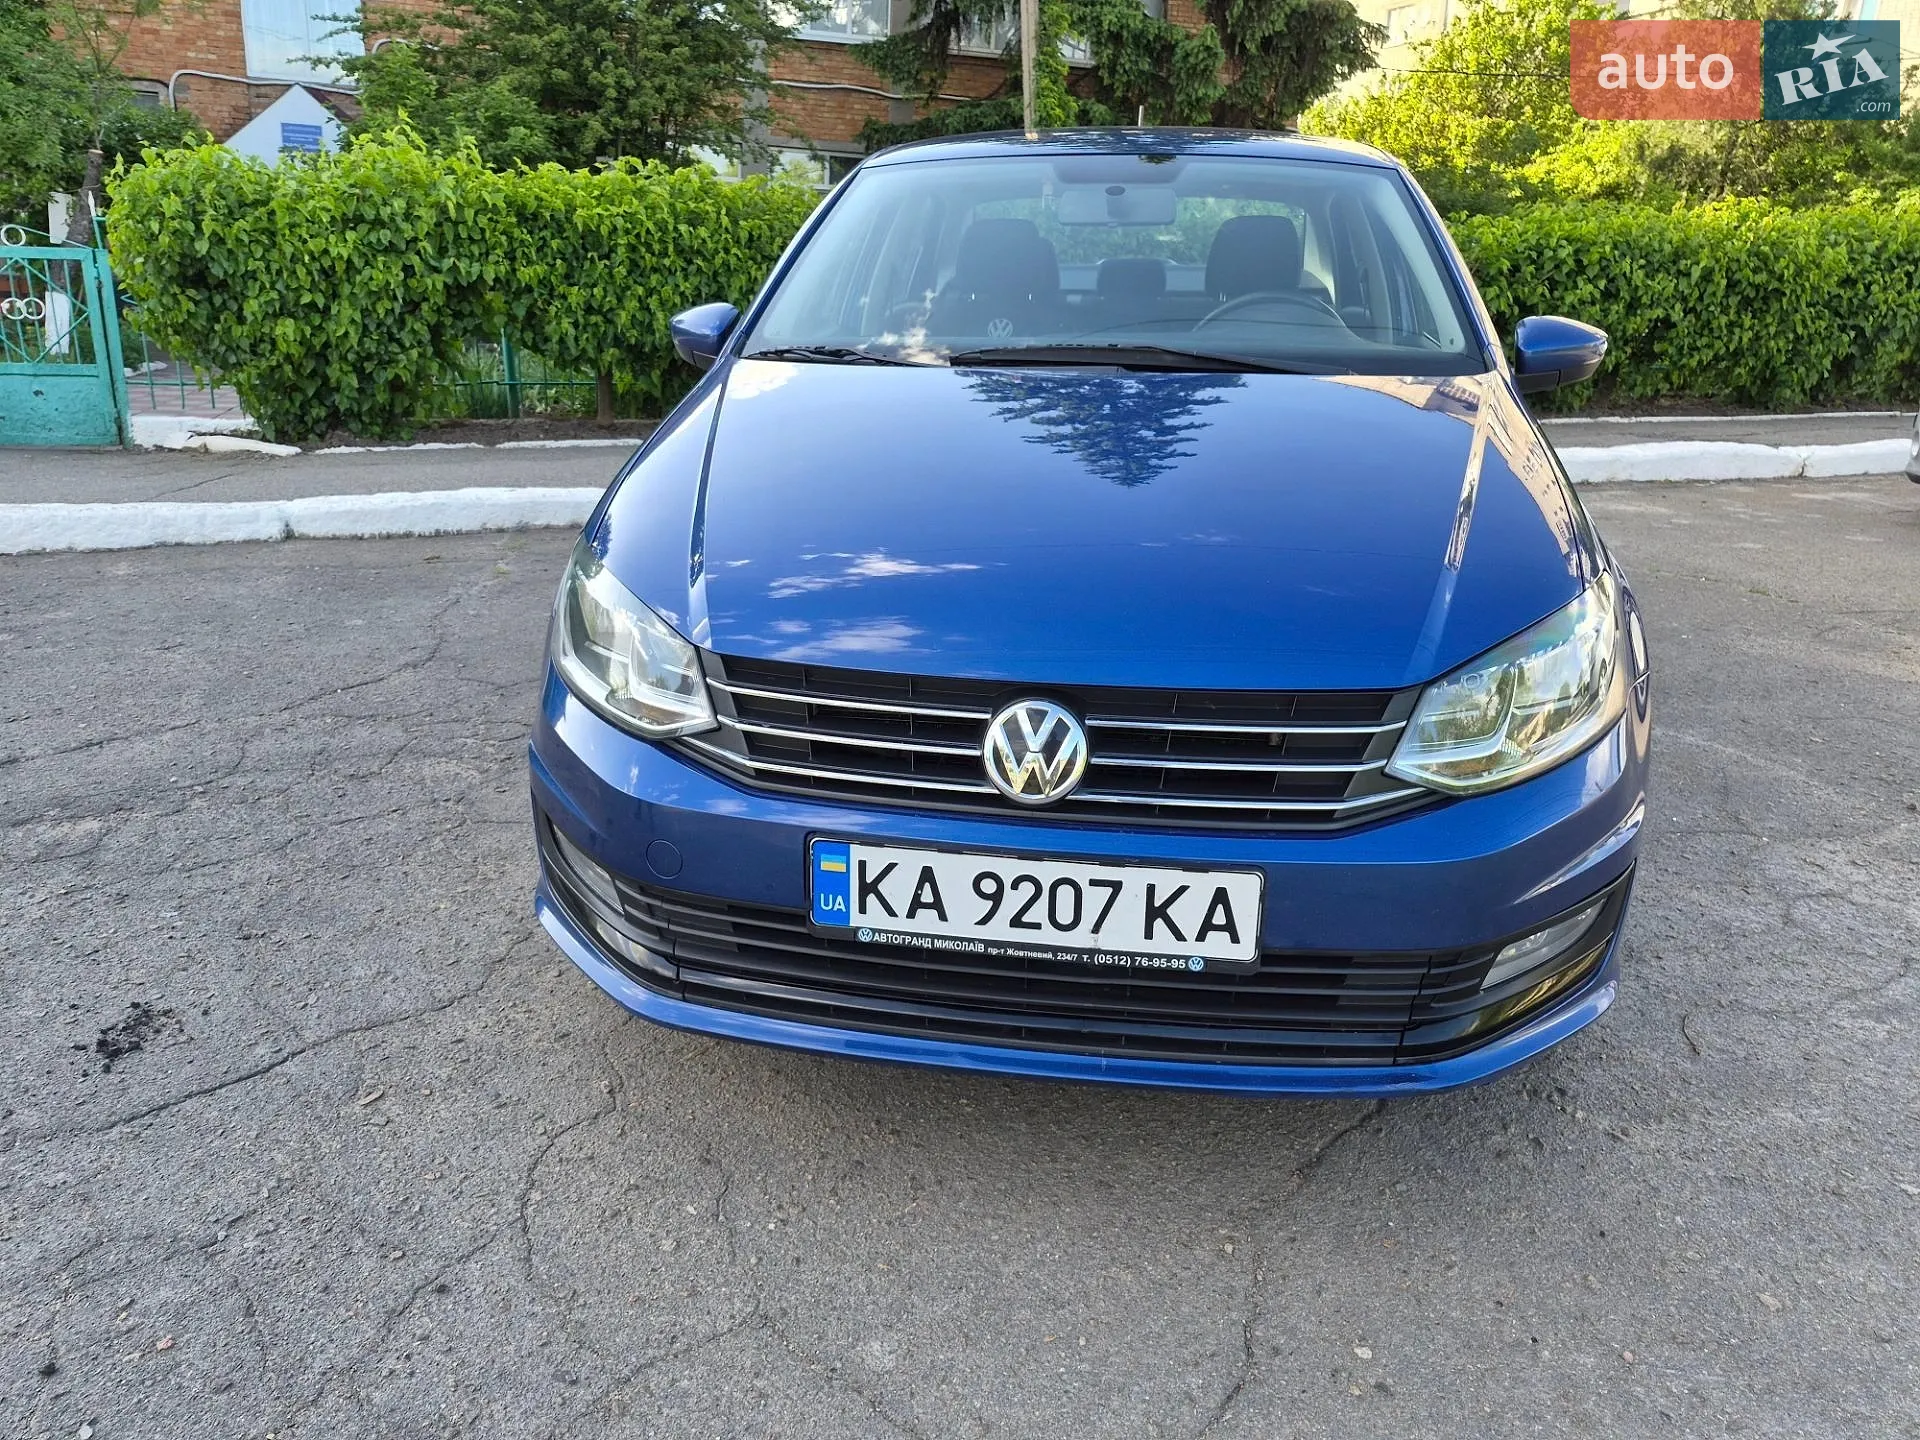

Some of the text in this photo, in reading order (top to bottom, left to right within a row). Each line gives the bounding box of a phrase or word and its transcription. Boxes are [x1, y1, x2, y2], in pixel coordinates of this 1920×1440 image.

[820, 893, 846, 912] UA
[858, 859, 1240, 944] KA 9207 KA
[873, 932, 932, 949] АВТОГРАНД
[934, 939, 985, 953] МИКОЛАЇВ
[987, 947, 1005, 955] пр-т
[1094, 953, 1132, 967] (0512)
[1134, 956, 1186, 969] 76-95-95
